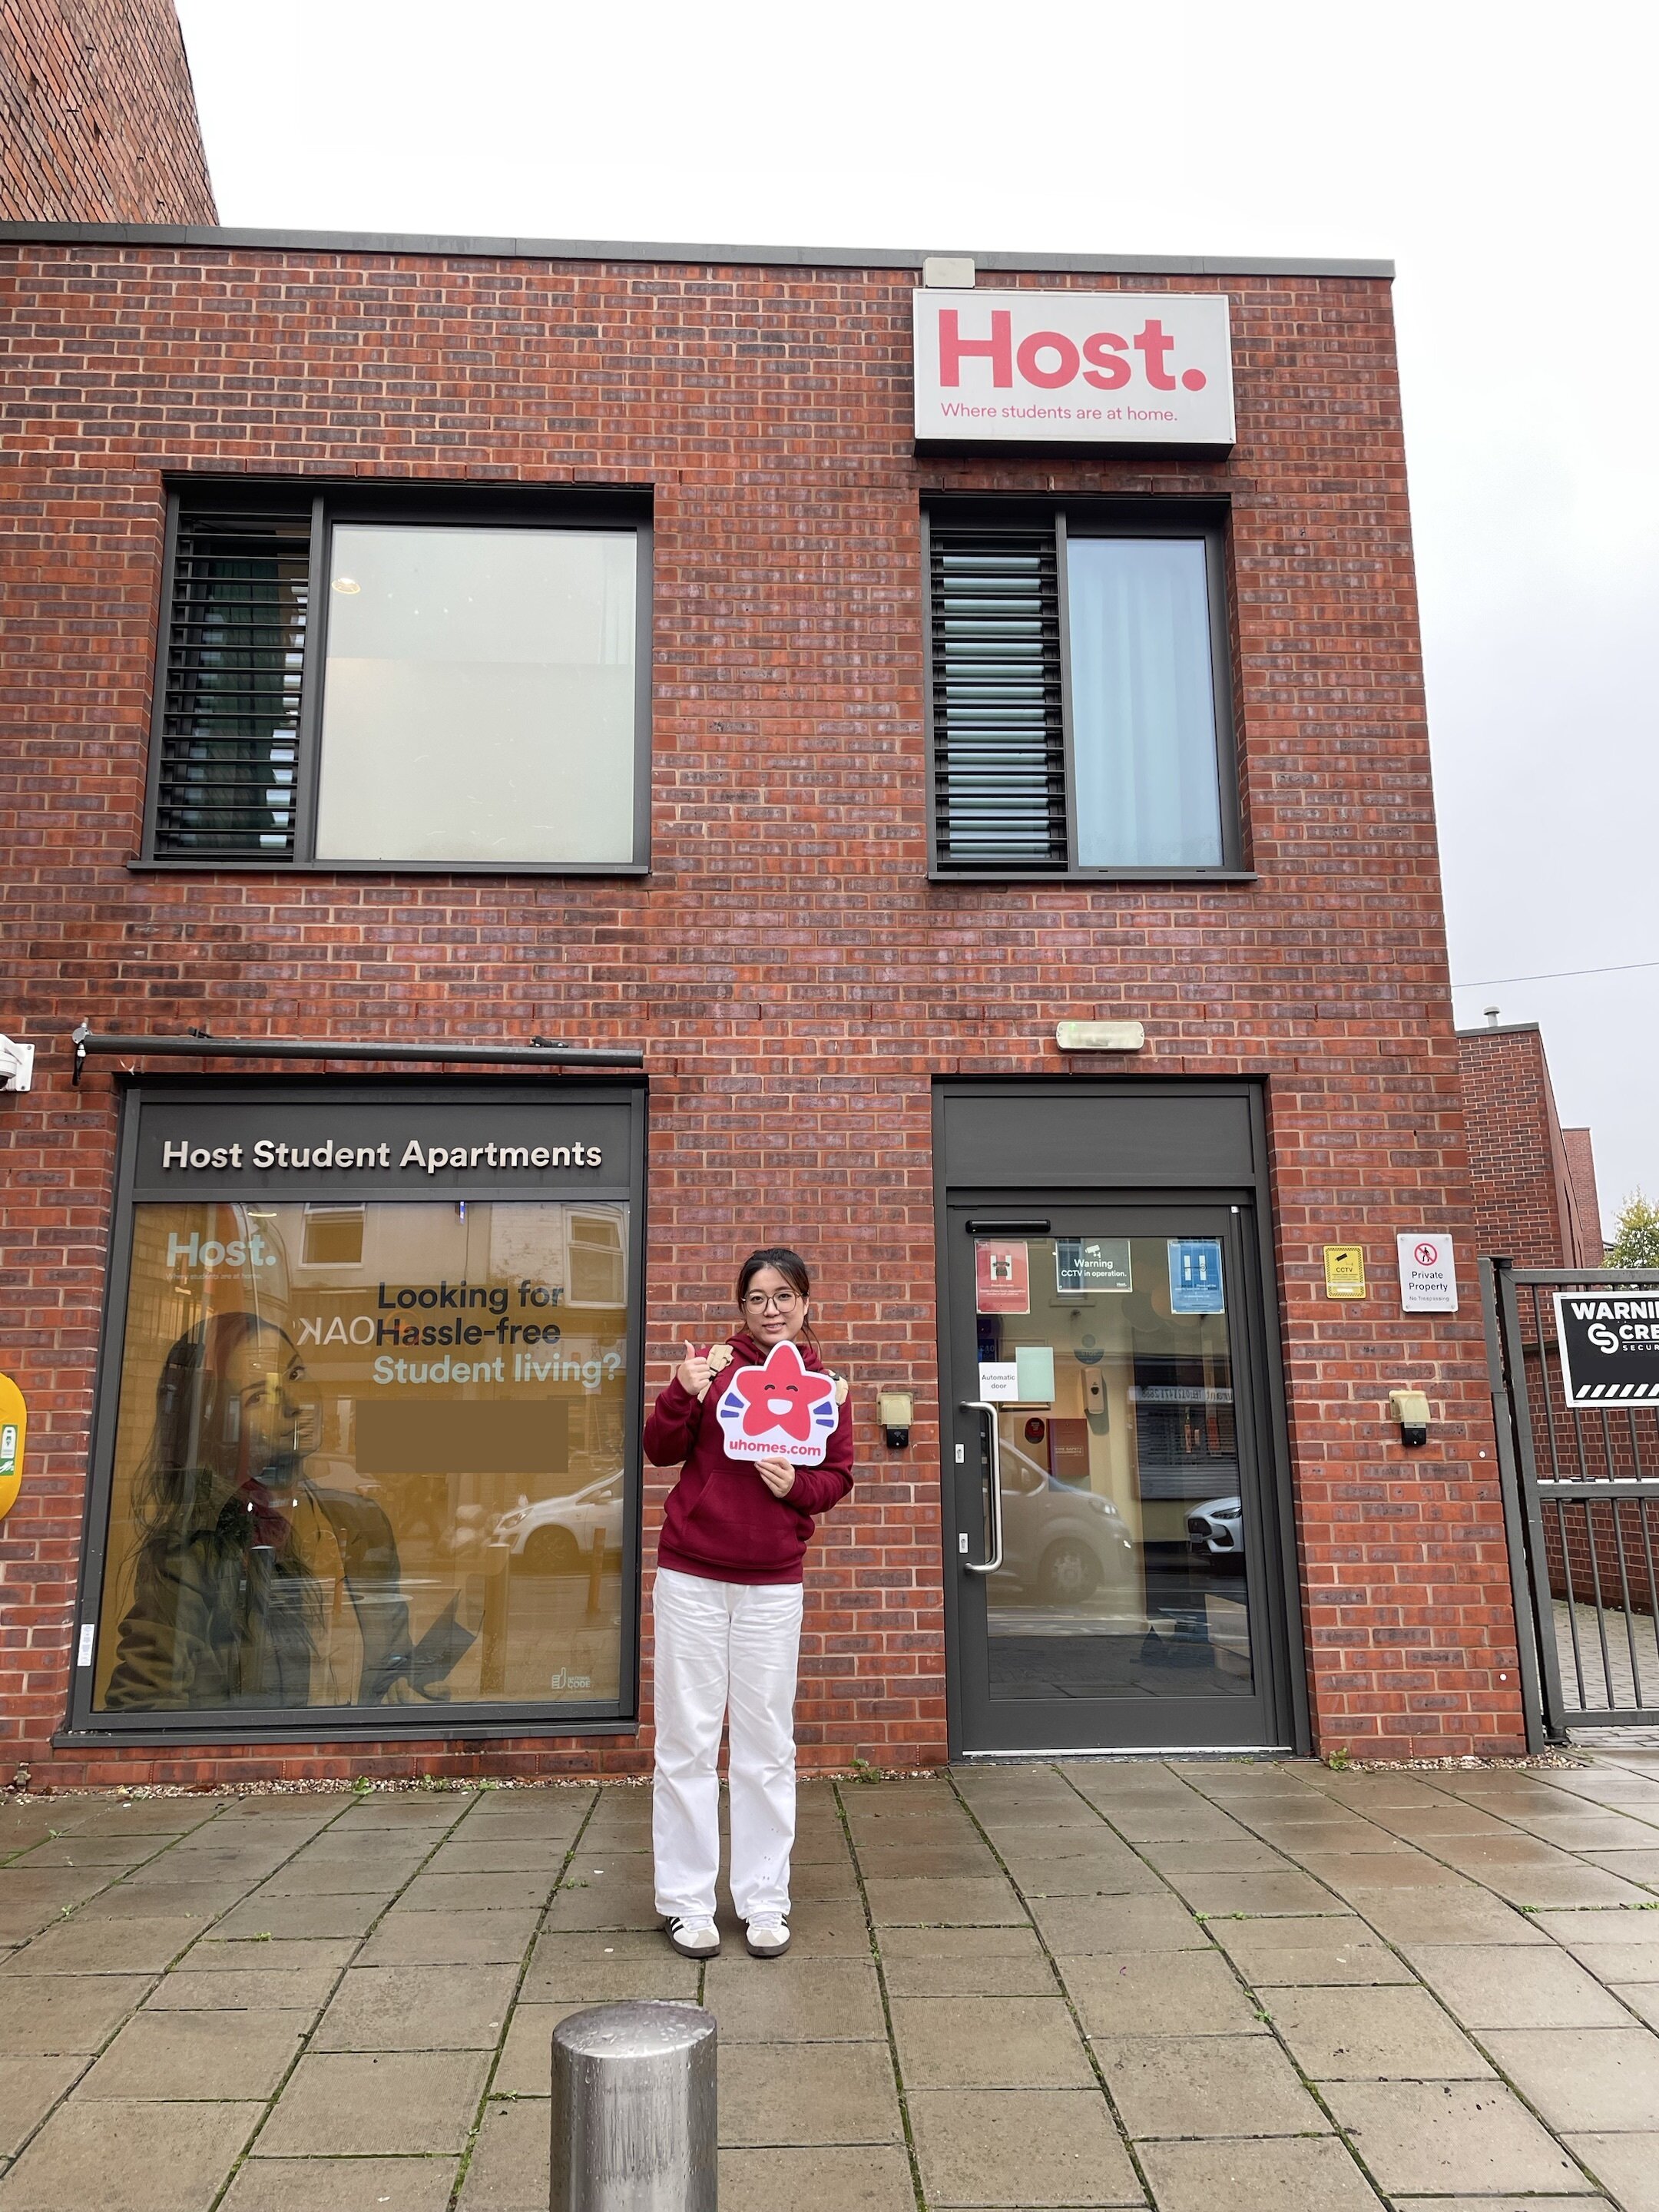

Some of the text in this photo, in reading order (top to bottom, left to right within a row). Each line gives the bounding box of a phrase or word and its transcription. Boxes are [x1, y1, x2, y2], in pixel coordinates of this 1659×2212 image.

[939, 309, 1207, 391] Host.
[940, 402, 1178, 421] Where students are at home.
[162, 1140, 603, 1174] Host Student Apartments
[167, 1232, 276, 1267] Host.
[1074, 1259, 1113, 1270] Warning
[1091, 1270, 1127, 1278] operation.
[378, 1280, 564, 1314] Looking for
[1409, 1282, 1448, 1292] Property
[1571, 1301, 1659, 1320] WARNI
[376, 1317, 561, 1346] Hassle-free
[373, 1353, 621, 1389] Student living?
[730, 1439, 821, 1457] uhomes.com
